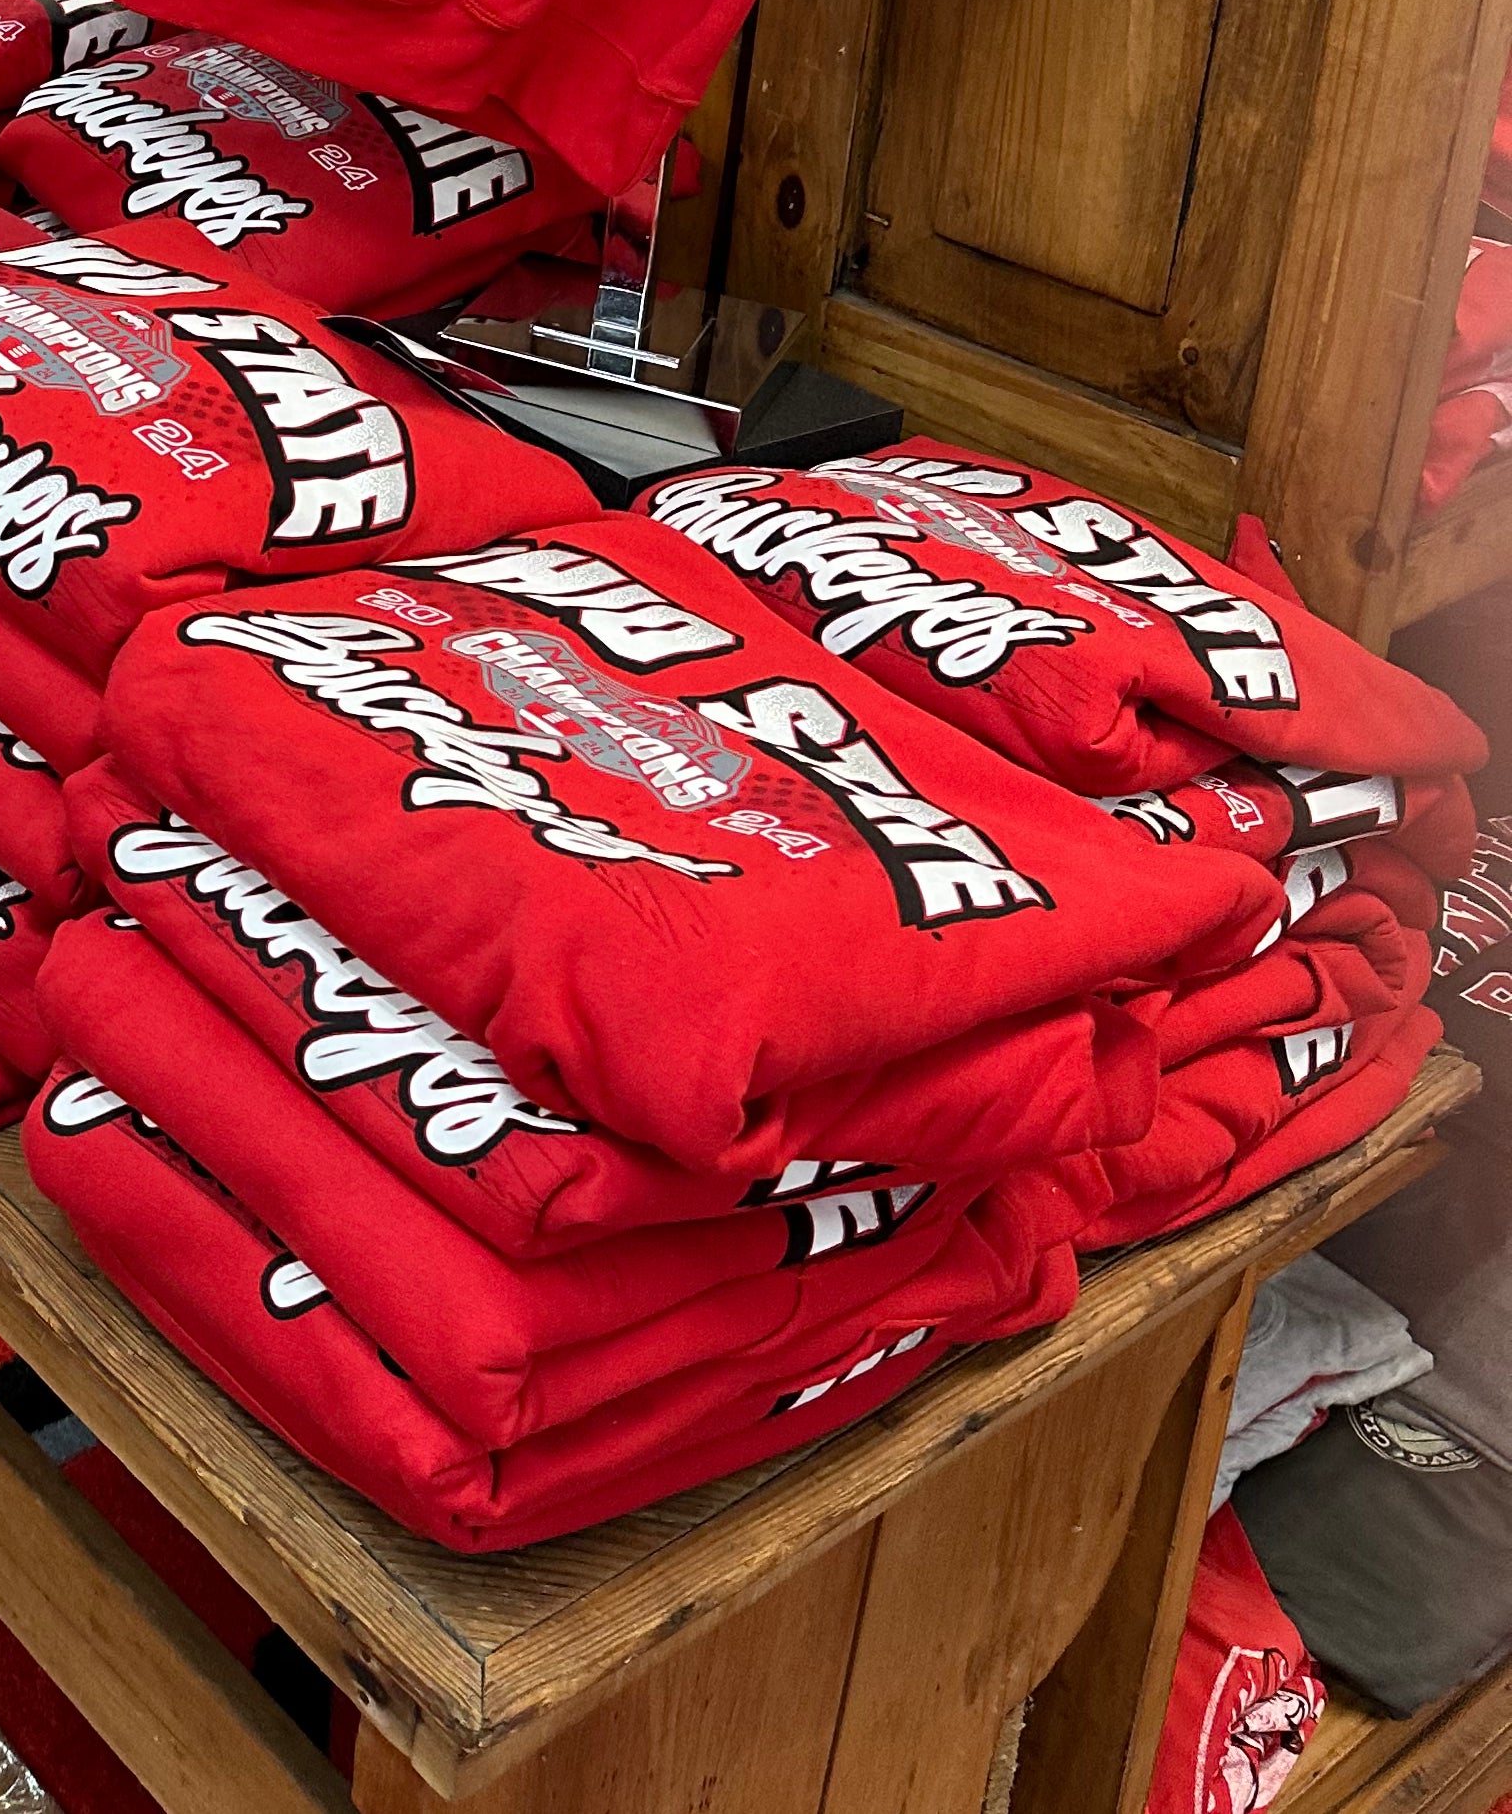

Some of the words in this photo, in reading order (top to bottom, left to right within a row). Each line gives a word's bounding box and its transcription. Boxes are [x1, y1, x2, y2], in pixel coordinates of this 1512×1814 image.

[15, 60, 311, 250] Buckeyes
[172, 47, 331, 137] CHAMPIONS
[307, 143, 379, 191] 24
[364, 93, 532, 228] ATE
[28, 287, 170, 375] NATIONAL
[131, 417, 230, 480] 24
[162, 308, 411, 544] STATE
[356, 586, 454, 626] 20
[376, 544, 735, 666] HIO
[647, 471, 1094, 683] Buckeyes
[1016, 498, 1300, 709] STATE
[185, 611, 744, 883] Buckey
[448, 629, 730, 809] CHAMPIONS
[533, 644, 722, 770] NATIONAL
[707, 808, 831, 860] 24
